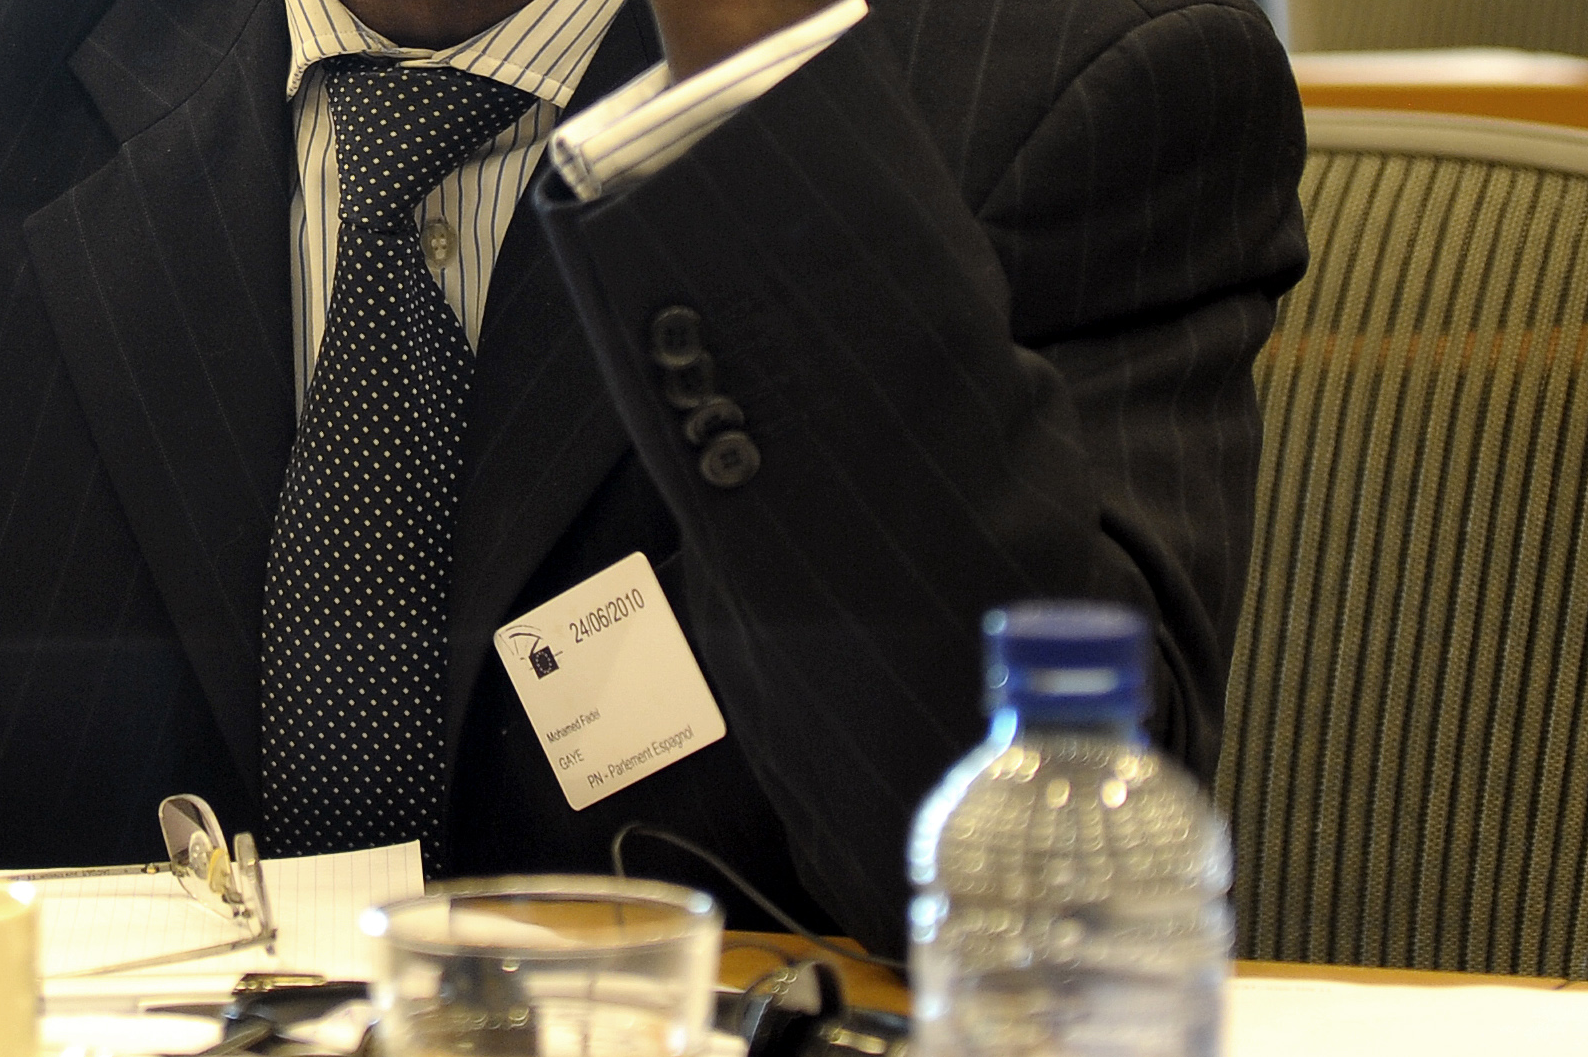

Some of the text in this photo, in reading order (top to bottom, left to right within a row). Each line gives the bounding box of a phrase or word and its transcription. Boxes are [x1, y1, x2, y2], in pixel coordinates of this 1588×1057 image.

[569, 588, 645, 644] 24/06/2010
[546, 718, 582, 743] Mohamed
[558, 748, 585, 770] GAYE
[587, 770, 604, 788] PN
[607, 746, 654, 778] Parlement
[651, 724, 695, 756] Espagnol
